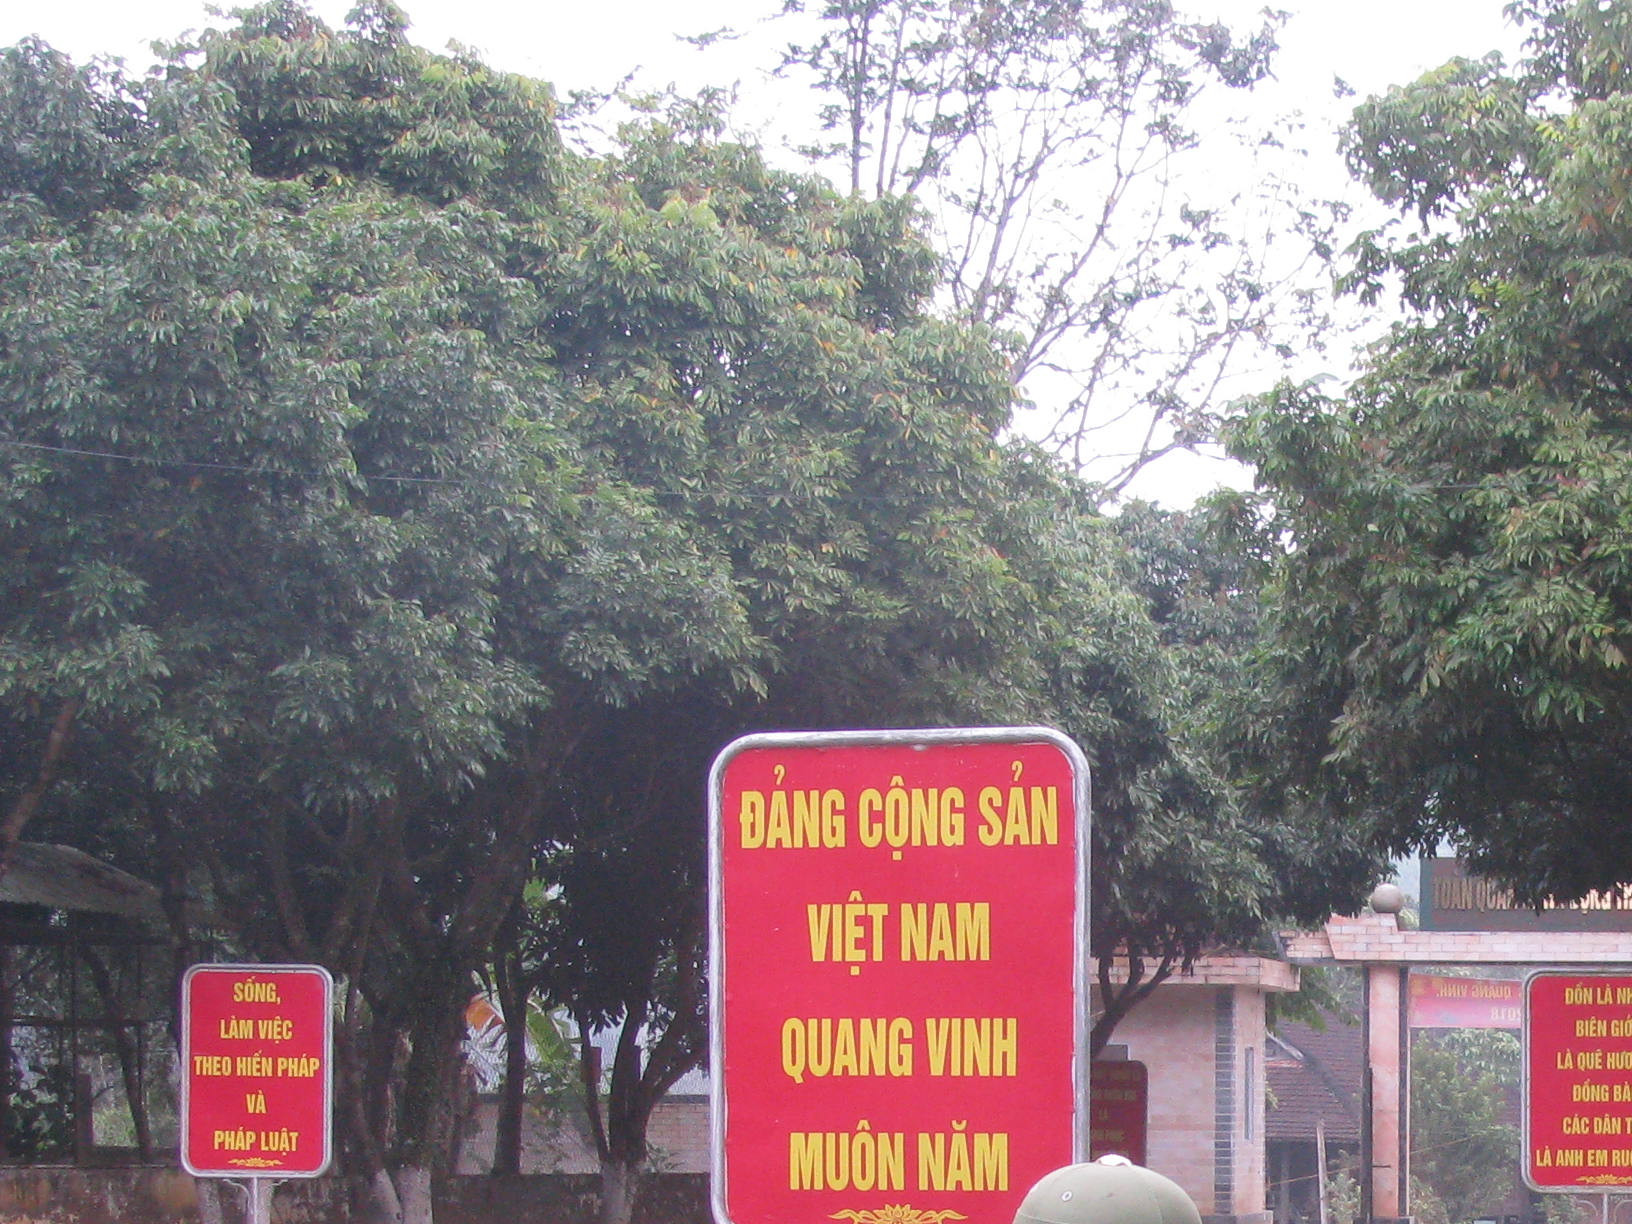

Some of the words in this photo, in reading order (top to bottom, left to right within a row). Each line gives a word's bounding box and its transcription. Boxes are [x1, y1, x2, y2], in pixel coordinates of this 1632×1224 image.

[740, 765, 845, 848] ĐẢNG
[859, 776, 964, 860] CỘNG
[979, 761, 1057, 846] SẢN
[808, 891, 888, 975] VIỆT
[901, 903, 989, 961] NAM
[234, 976, 280, 1004] SỐNG,
[1597, 984, 1613, 1004] LÀ
[221, 1016, 253, 1039] LÀM
[258, 1016, 292, 1043] VIỆC
[1576, 1017, 1607, 1037] BIÊN
[194, 1056, 231, 1076] THEO
[237, 1050, 272, 1076] HIẾN
[278, 1054, 320, 1077] PHÁP
[782, 1018, 912, 1083] QUANG
[926, 1018, 1016, 1076] VINH
[1557, 1049, 1573, 1069] LÀ
[1577, 1049, 1602, 1071] QUÊ
[246, 1090, 266, 1113] VÀ
[1563, 1114, 1589, 1134] CÁC
[1594, 1114, 1621, 1134] DÂN
[214, 1127, 256, 1150] PHÁP
[261, 1128, 298, 1155] LUẬT
[790, 1120, 904, 1191] MUÔN
[919, 1118, 1008, 1191] NĂM
[1536, 1146, 1552, 1166] LÀ
[1556, 1150, 1583, 1166] ANH
[1588, 1150, 1608, 1166] EM
